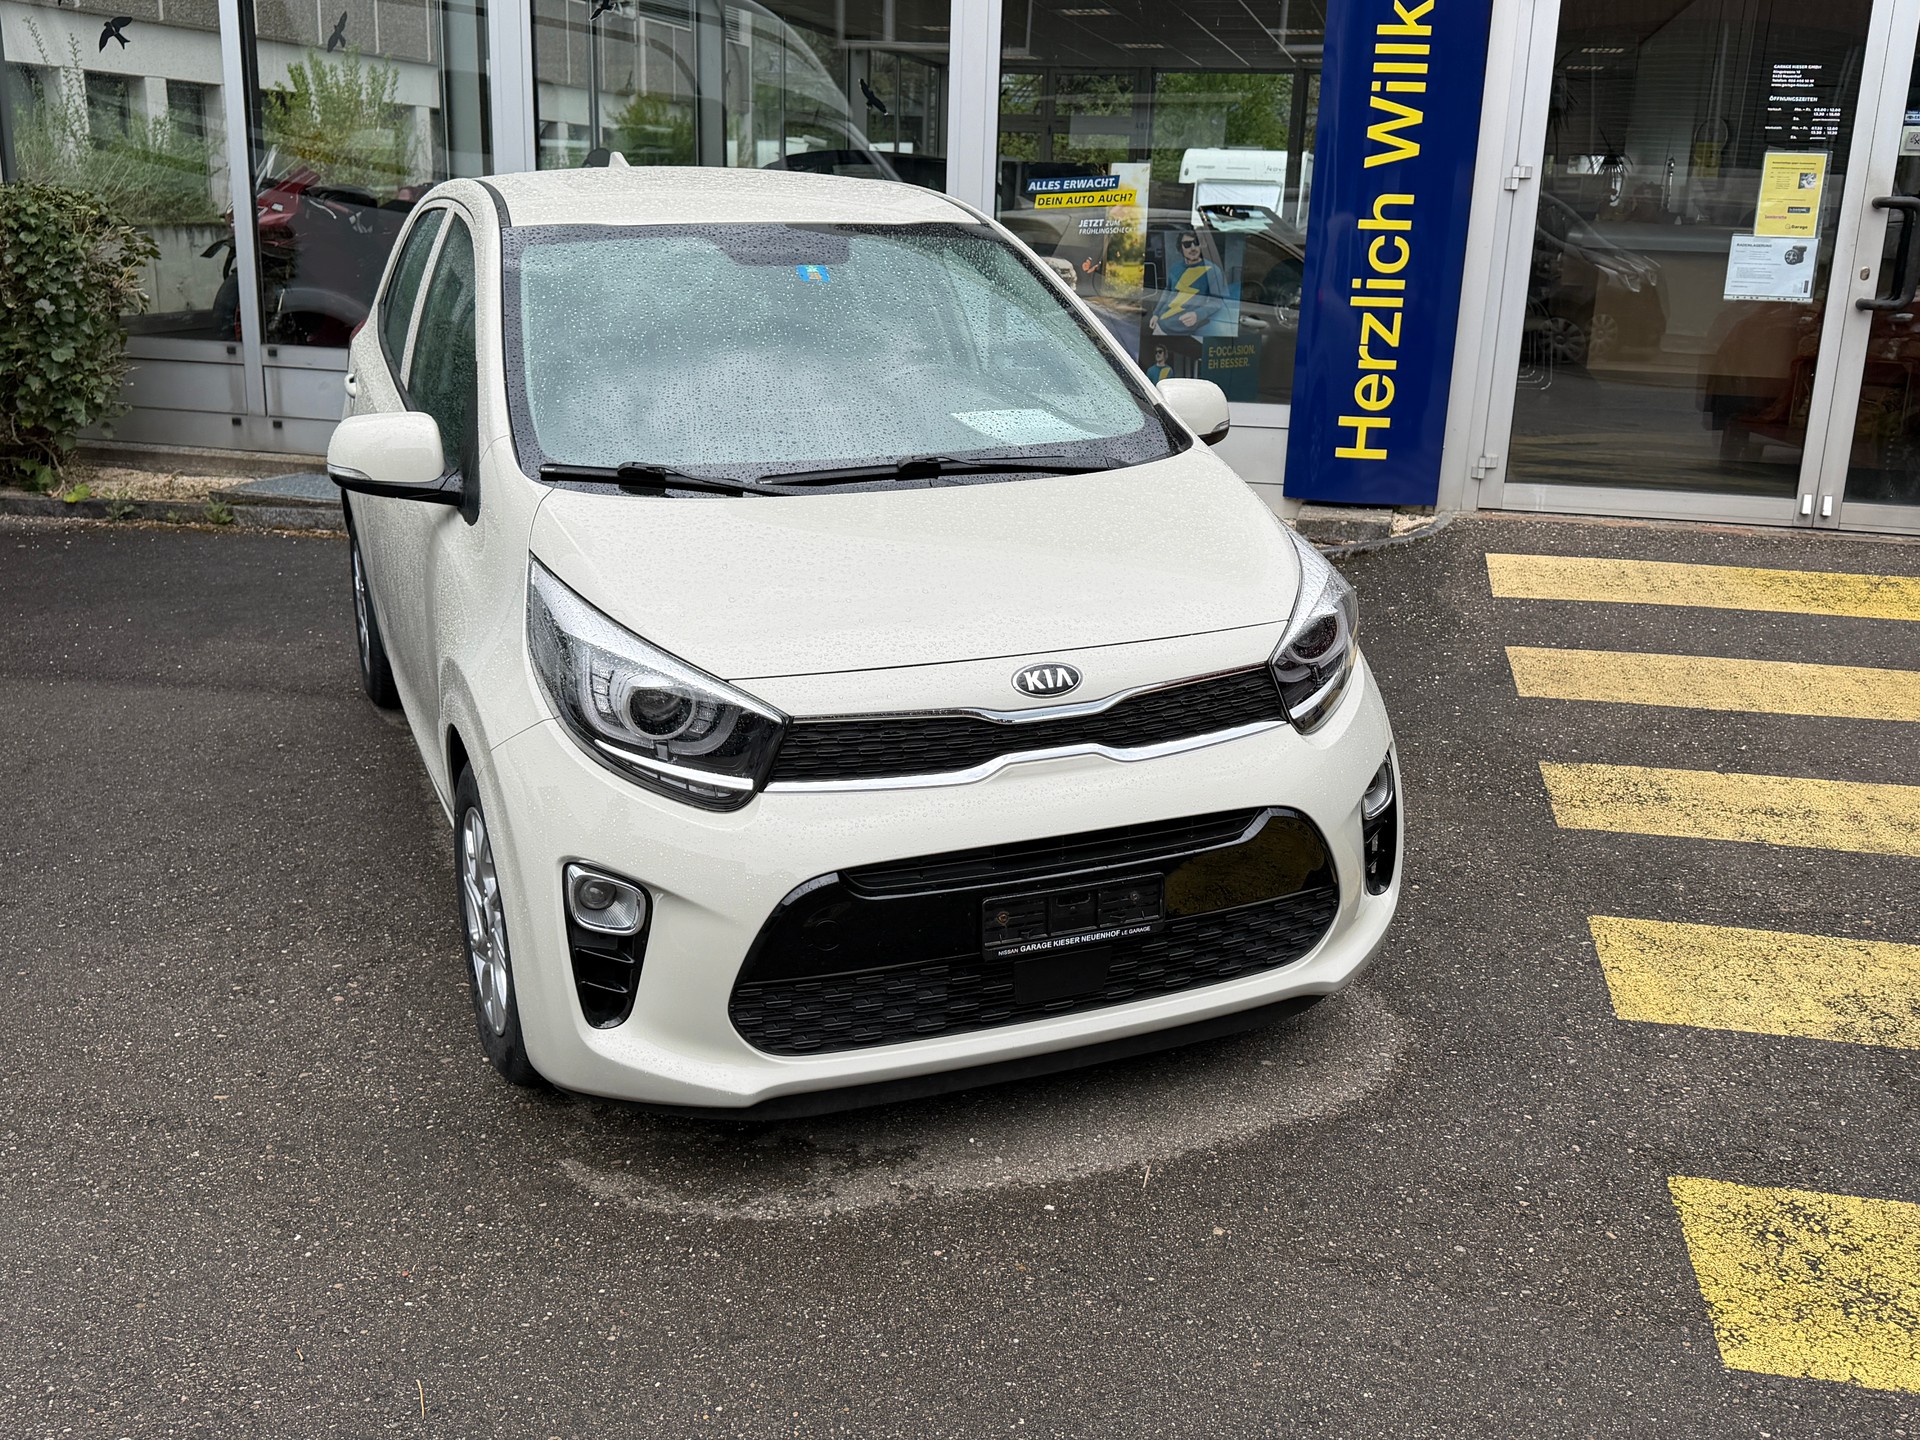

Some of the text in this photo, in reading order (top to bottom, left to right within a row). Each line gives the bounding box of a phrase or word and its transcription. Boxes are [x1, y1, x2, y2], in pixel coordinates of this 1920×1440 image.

[1028, 178, 1116, 191] ALLES ERWACHT.
[1037, 193, 1133, 206] DEIN AUTO AUCH?
[1078, 218, 1104, 228] JETZT
[1334, 0, 1435, 461] Herzlich Willk
[1208, 358, 1250, 369] EH BESSER.
[1023, 668, 1074, 691] KIA
[998, 948, 1019, 956] NISSAN
[1020, 941, 1052, 953] GARAGE
[1053, 936, 1080, 947] KIESER
[1081, 930, 1121, 943] NEUENHOF
[1128, 926, 1151, 935] GARAGE
